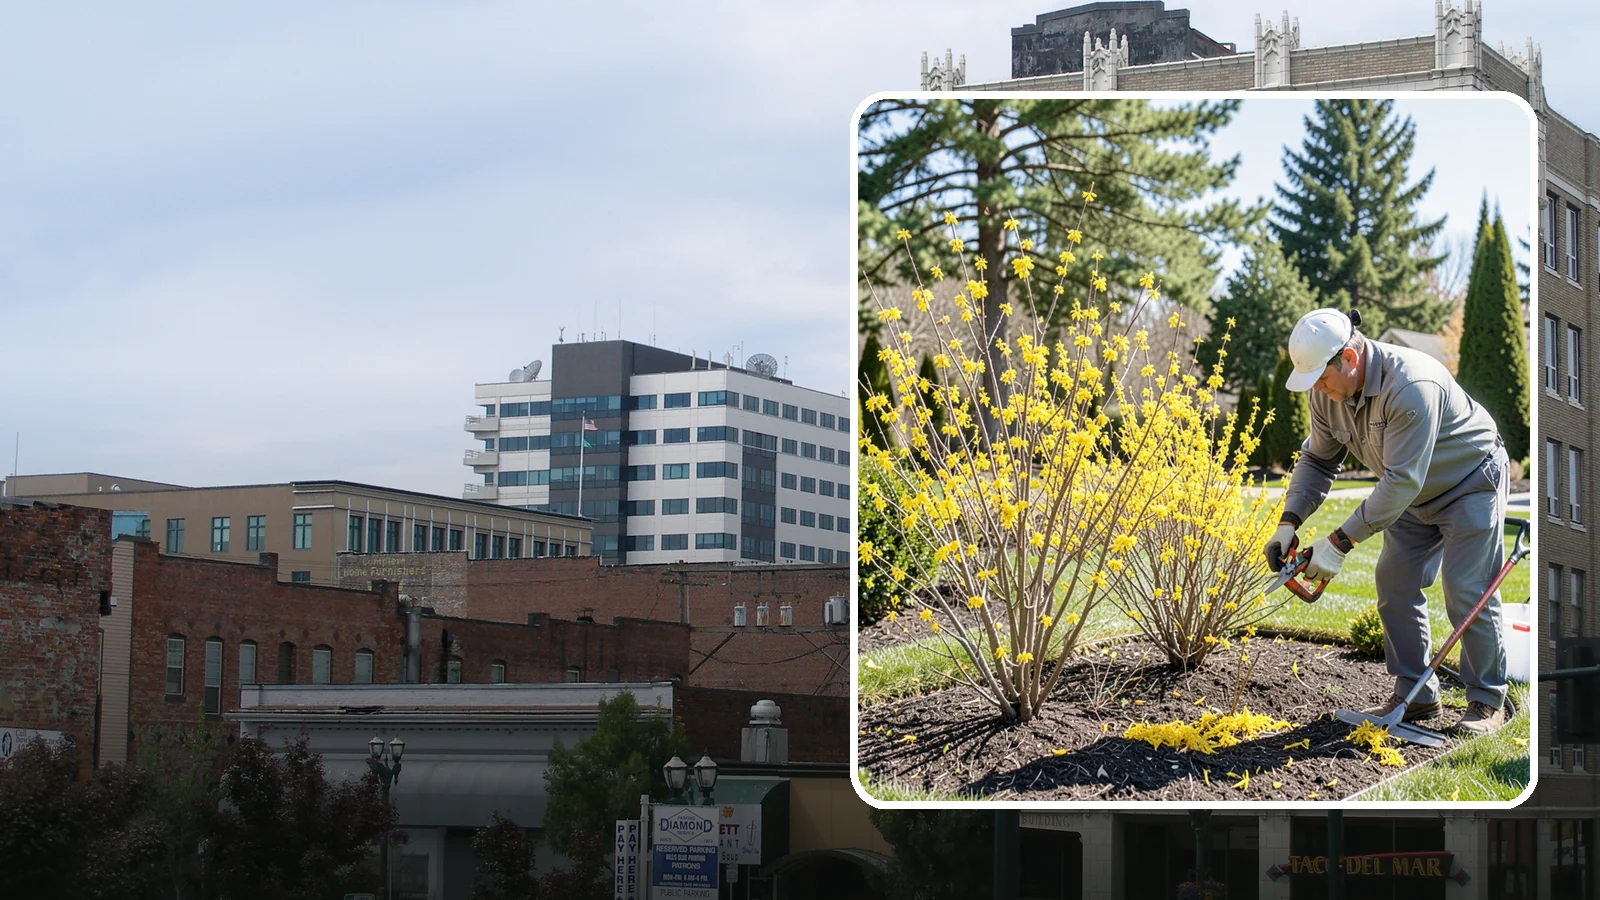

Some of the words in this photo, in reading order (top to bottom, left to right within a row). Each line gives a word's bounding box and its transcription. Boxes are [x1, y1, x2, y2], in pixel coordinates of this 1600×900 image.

[343, 568, 368, 577] Home
[370, 565, 427, 577] Furnishers
[660, 818, 713, 833] DIAMOND
[1022, 815, 1069, 827] BUILDING
[617, 825, 625, 852] PAY
[655, 845, 688, 853] RESERVED
[689, 846, 717, 854] PARKING
[721, 851, 738, 862] Soup
[671, 862, 701, 870] PATRONS
[1346, 856, 1385, 876] DEL
[1392, 857, 1443, 877] MAR
[628, 856, 636, 893] HERE
[660, 889, 682, 897] PUBLIC
[683, 890, 711, 898] PARKING
